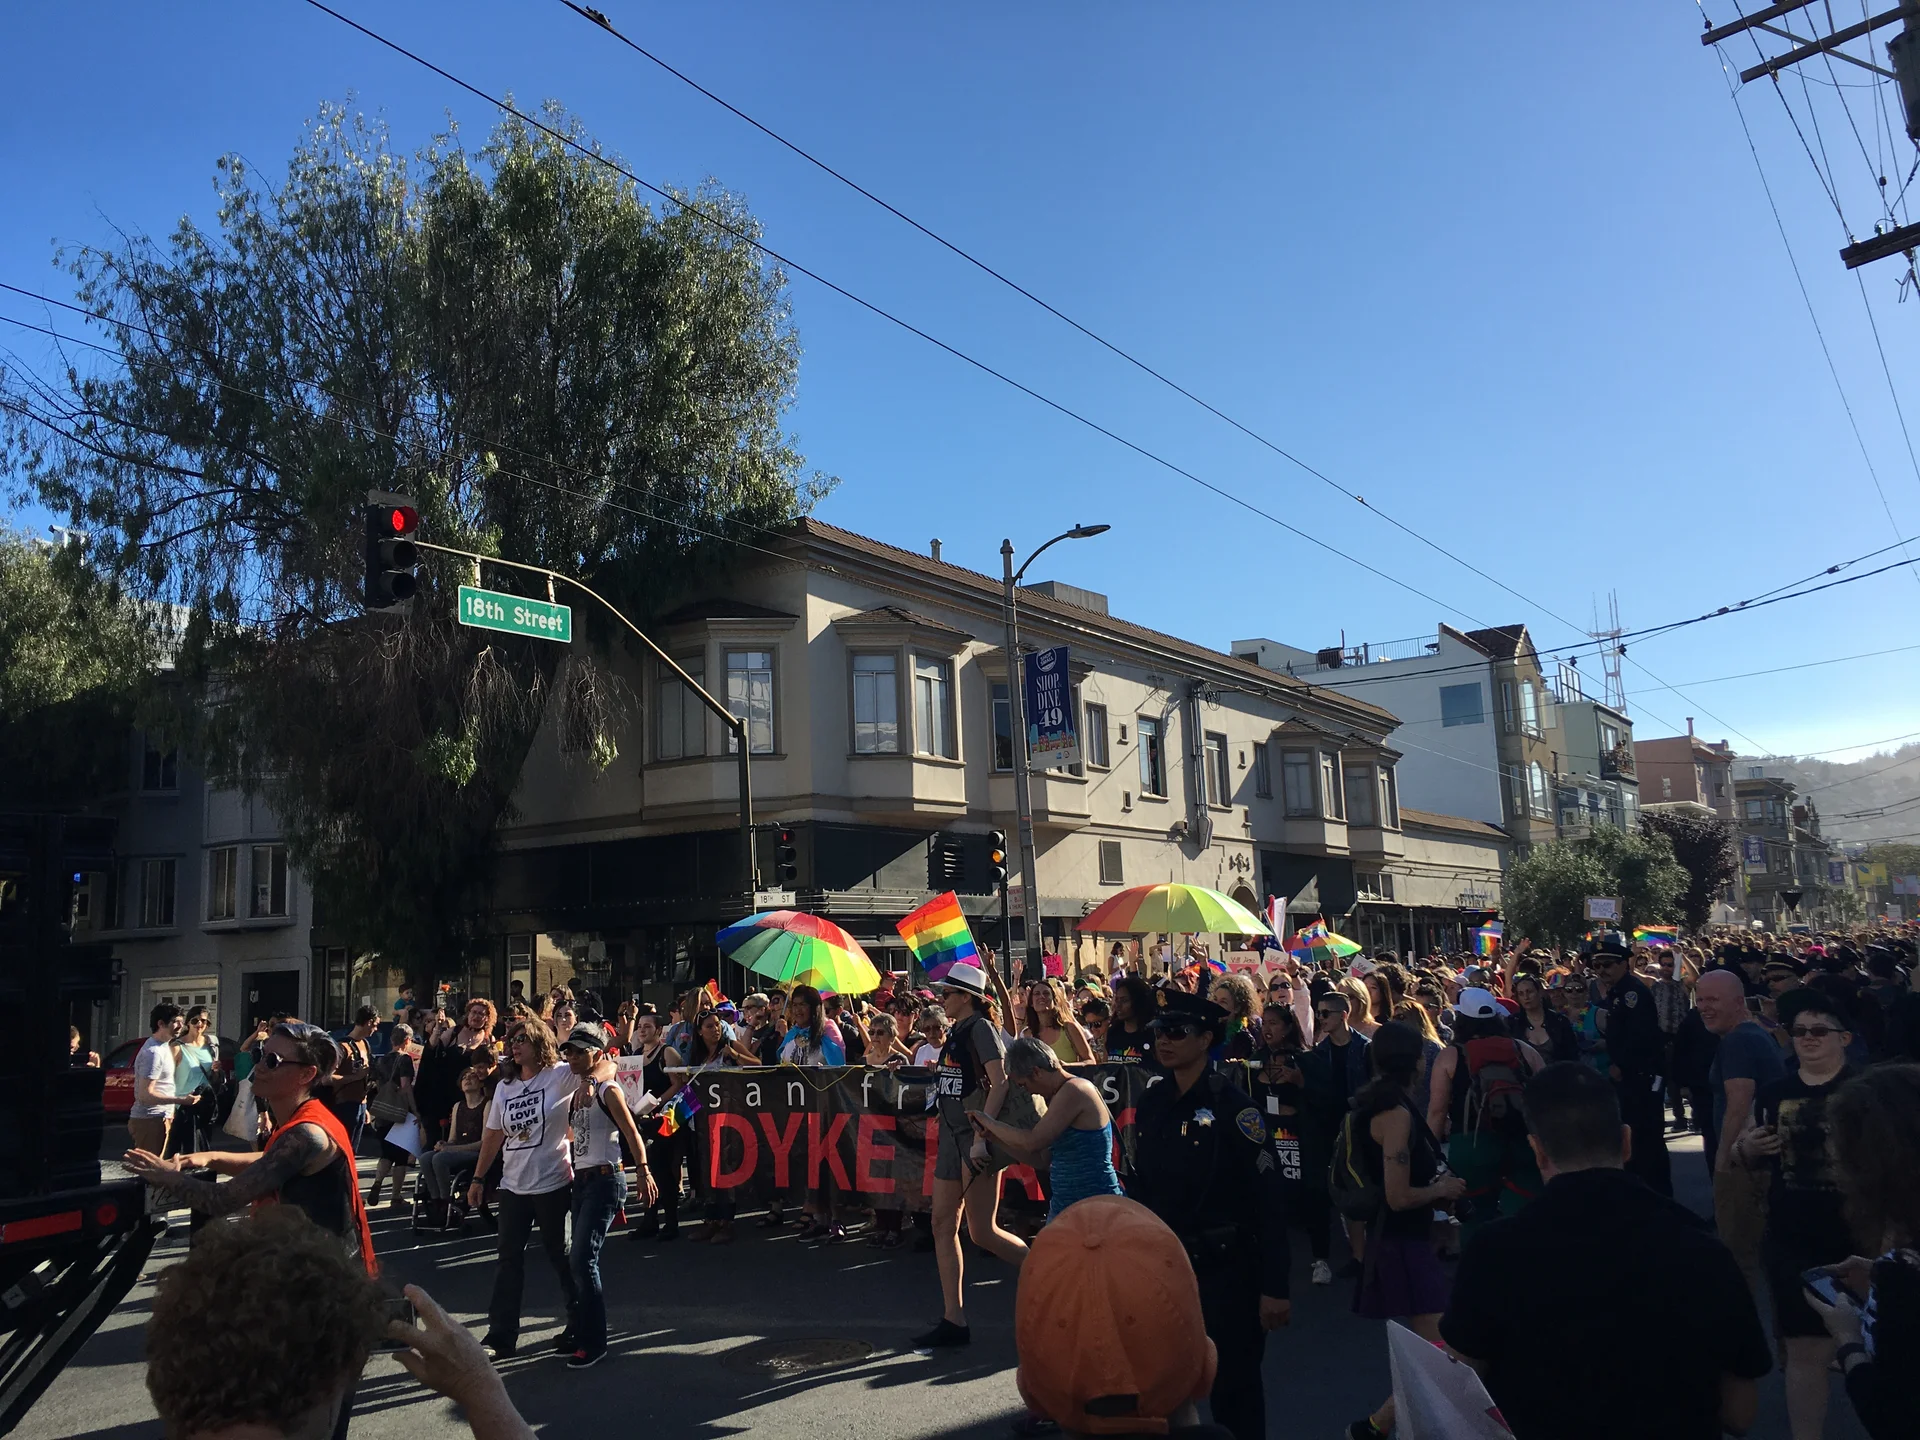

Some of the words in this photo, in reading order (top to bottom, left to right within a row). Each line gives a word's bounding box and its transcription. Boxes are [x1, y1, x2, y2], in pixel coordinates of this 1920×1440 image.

[466, 596, 504, 621] 18th
[513, 606, 563, 632] Street
[1036, 672, 1059, 693] SHOP
[1037, 688, 1061, 710] DINE
[1038, 707, 1063, 728] 49
[760, 895, 774, 904] 18TH
[781, 894, 790, 903] ST
[708, 1080, 805, 1109] san
[938, 1077, 963, 1095] KE
[508, 1096, 540, 1111] PEACE
[510, 1107, 536, 1122] LOVE
[708, 1111, 897, 1194] DYKE
